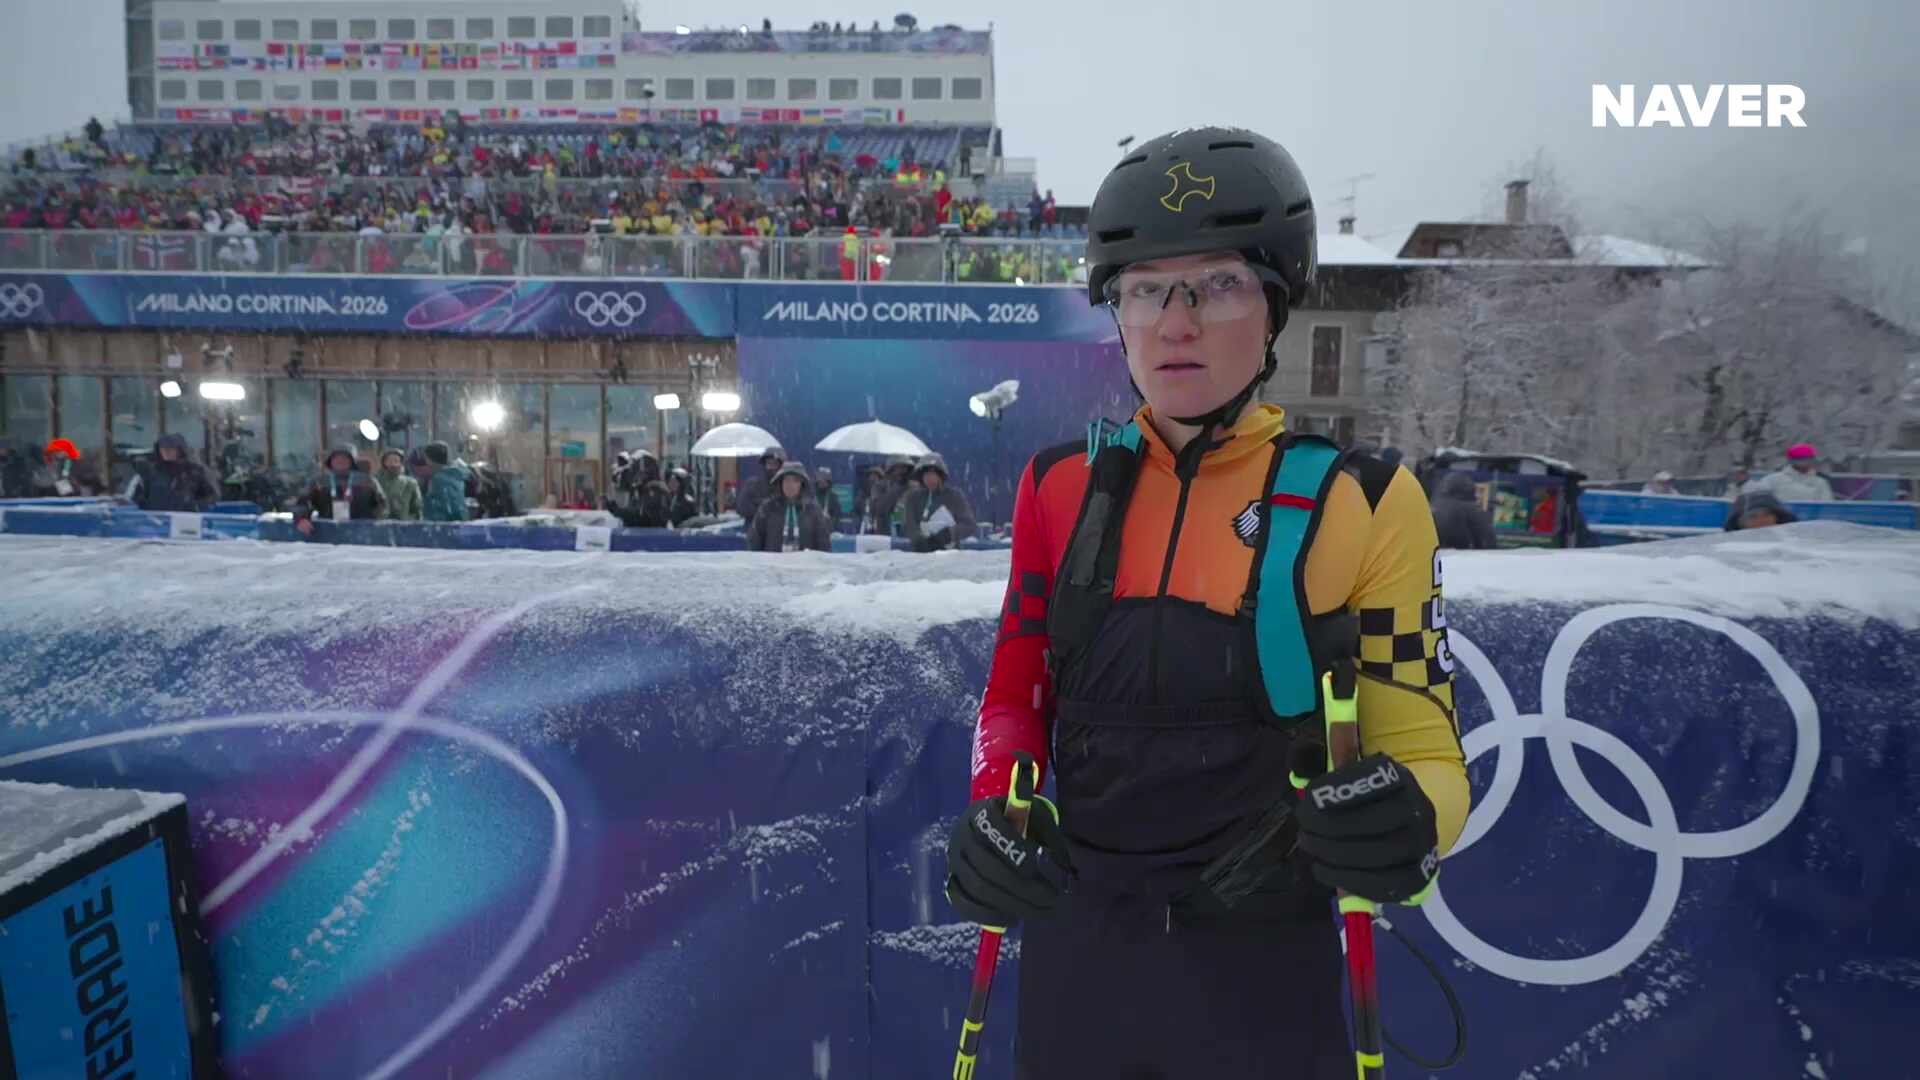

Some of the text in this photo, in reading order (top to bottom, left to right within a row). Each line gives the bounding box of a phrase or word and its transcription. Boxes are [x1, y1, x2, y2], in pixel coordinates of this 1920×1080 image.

[137, 293, 389, 315] MILANO CORTINA 2026
[763, 301, 1040, 323] MILANO CORTINA 2026
[974, 808, 1027, 868] Roeckl
[63, 884, 137, 1080] ERADE
